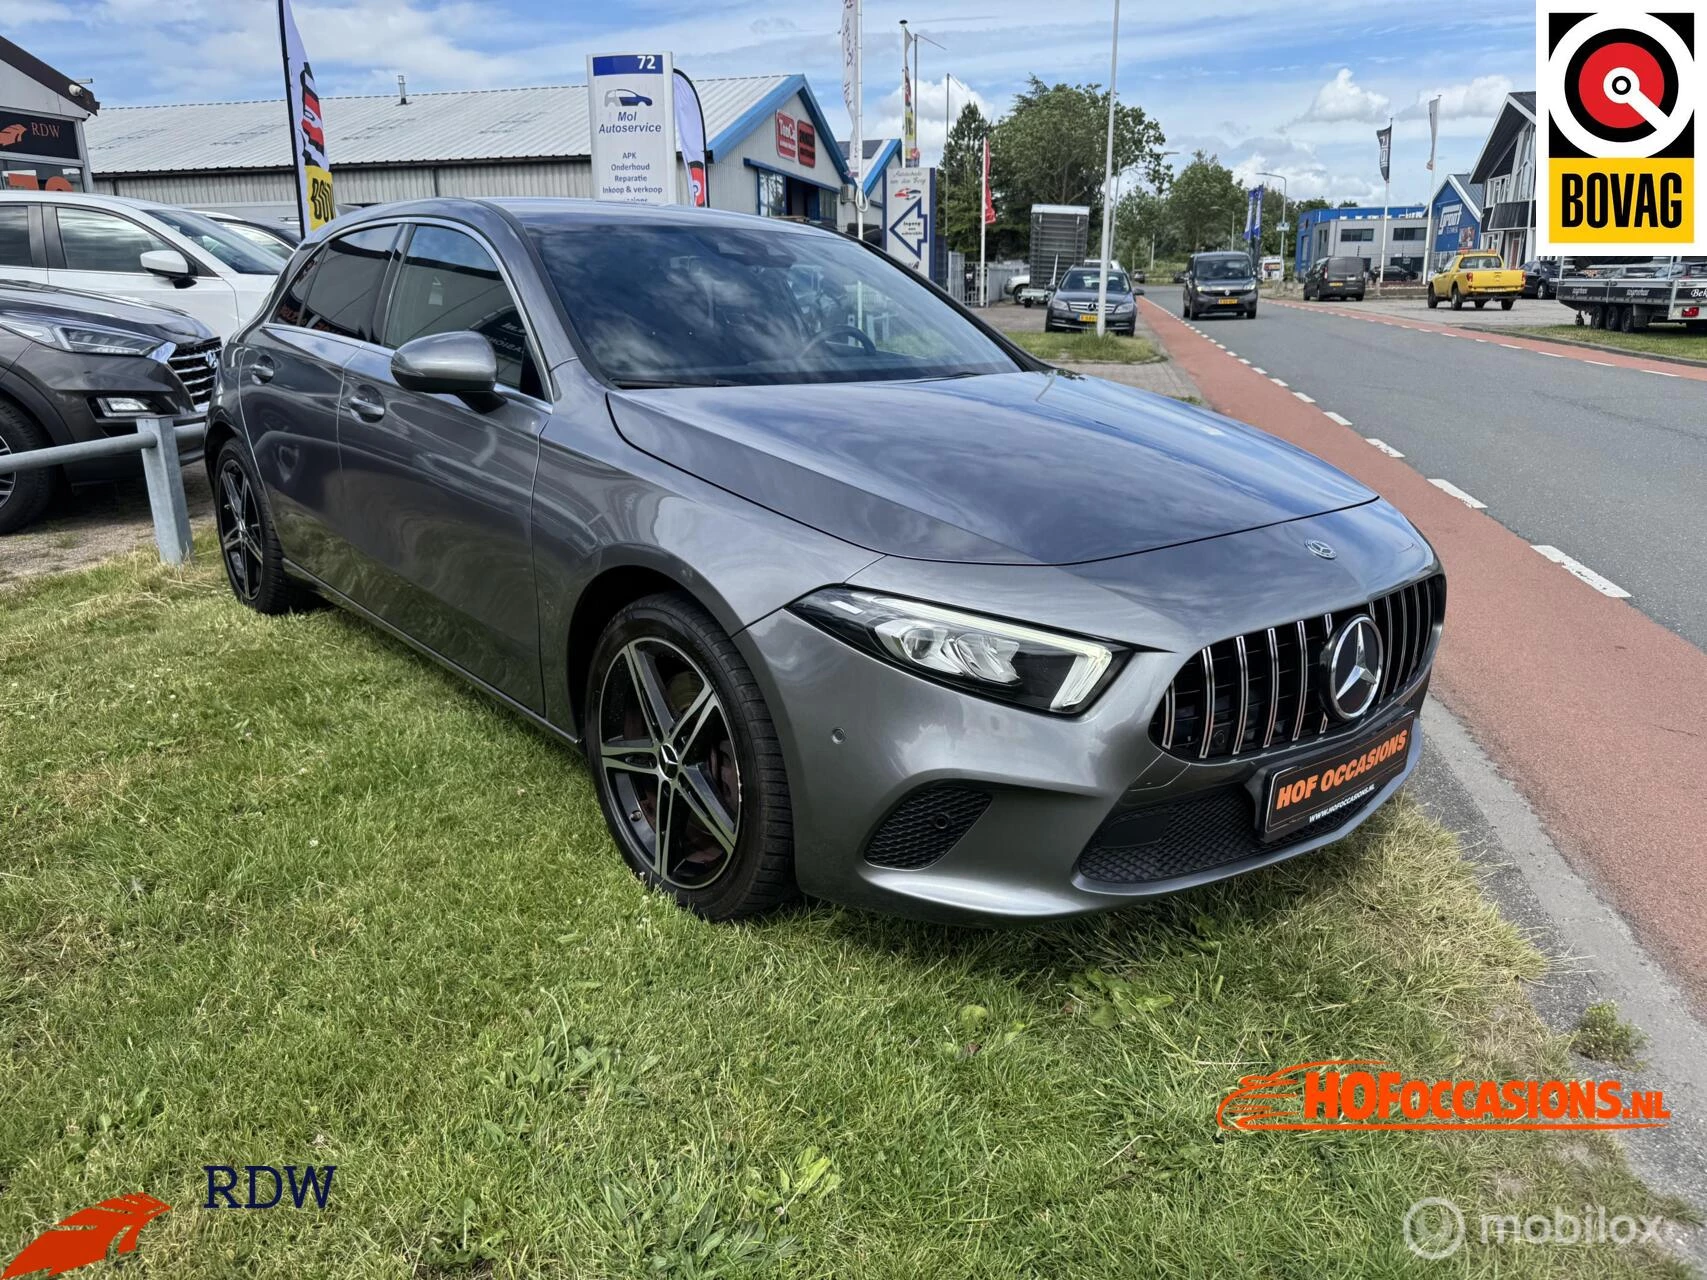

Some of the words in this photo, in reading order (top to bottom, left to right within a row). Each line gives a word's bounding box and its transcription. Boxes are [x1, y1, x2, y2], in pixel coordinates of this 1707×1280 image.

[637, 55, 656, 70] 72
[617, 111, 637, 121] Mol
[31, 121, 61, 138] RDW
[598, 122, 662, 134] Autoservice
[610, 163, 650, 171] Onderhoud
[614, 174, 648, 183] Reparatie
[602, 186, 625, 195] Inkoop
[633, 186, 663, 195] verkoop
[1276, 774, 1319, 810] HOF
[1320, 729, 1408, 792] OCCASIONS
[1309, 783, 1376, 823] WWW.HOFOCCASIONS.NL
